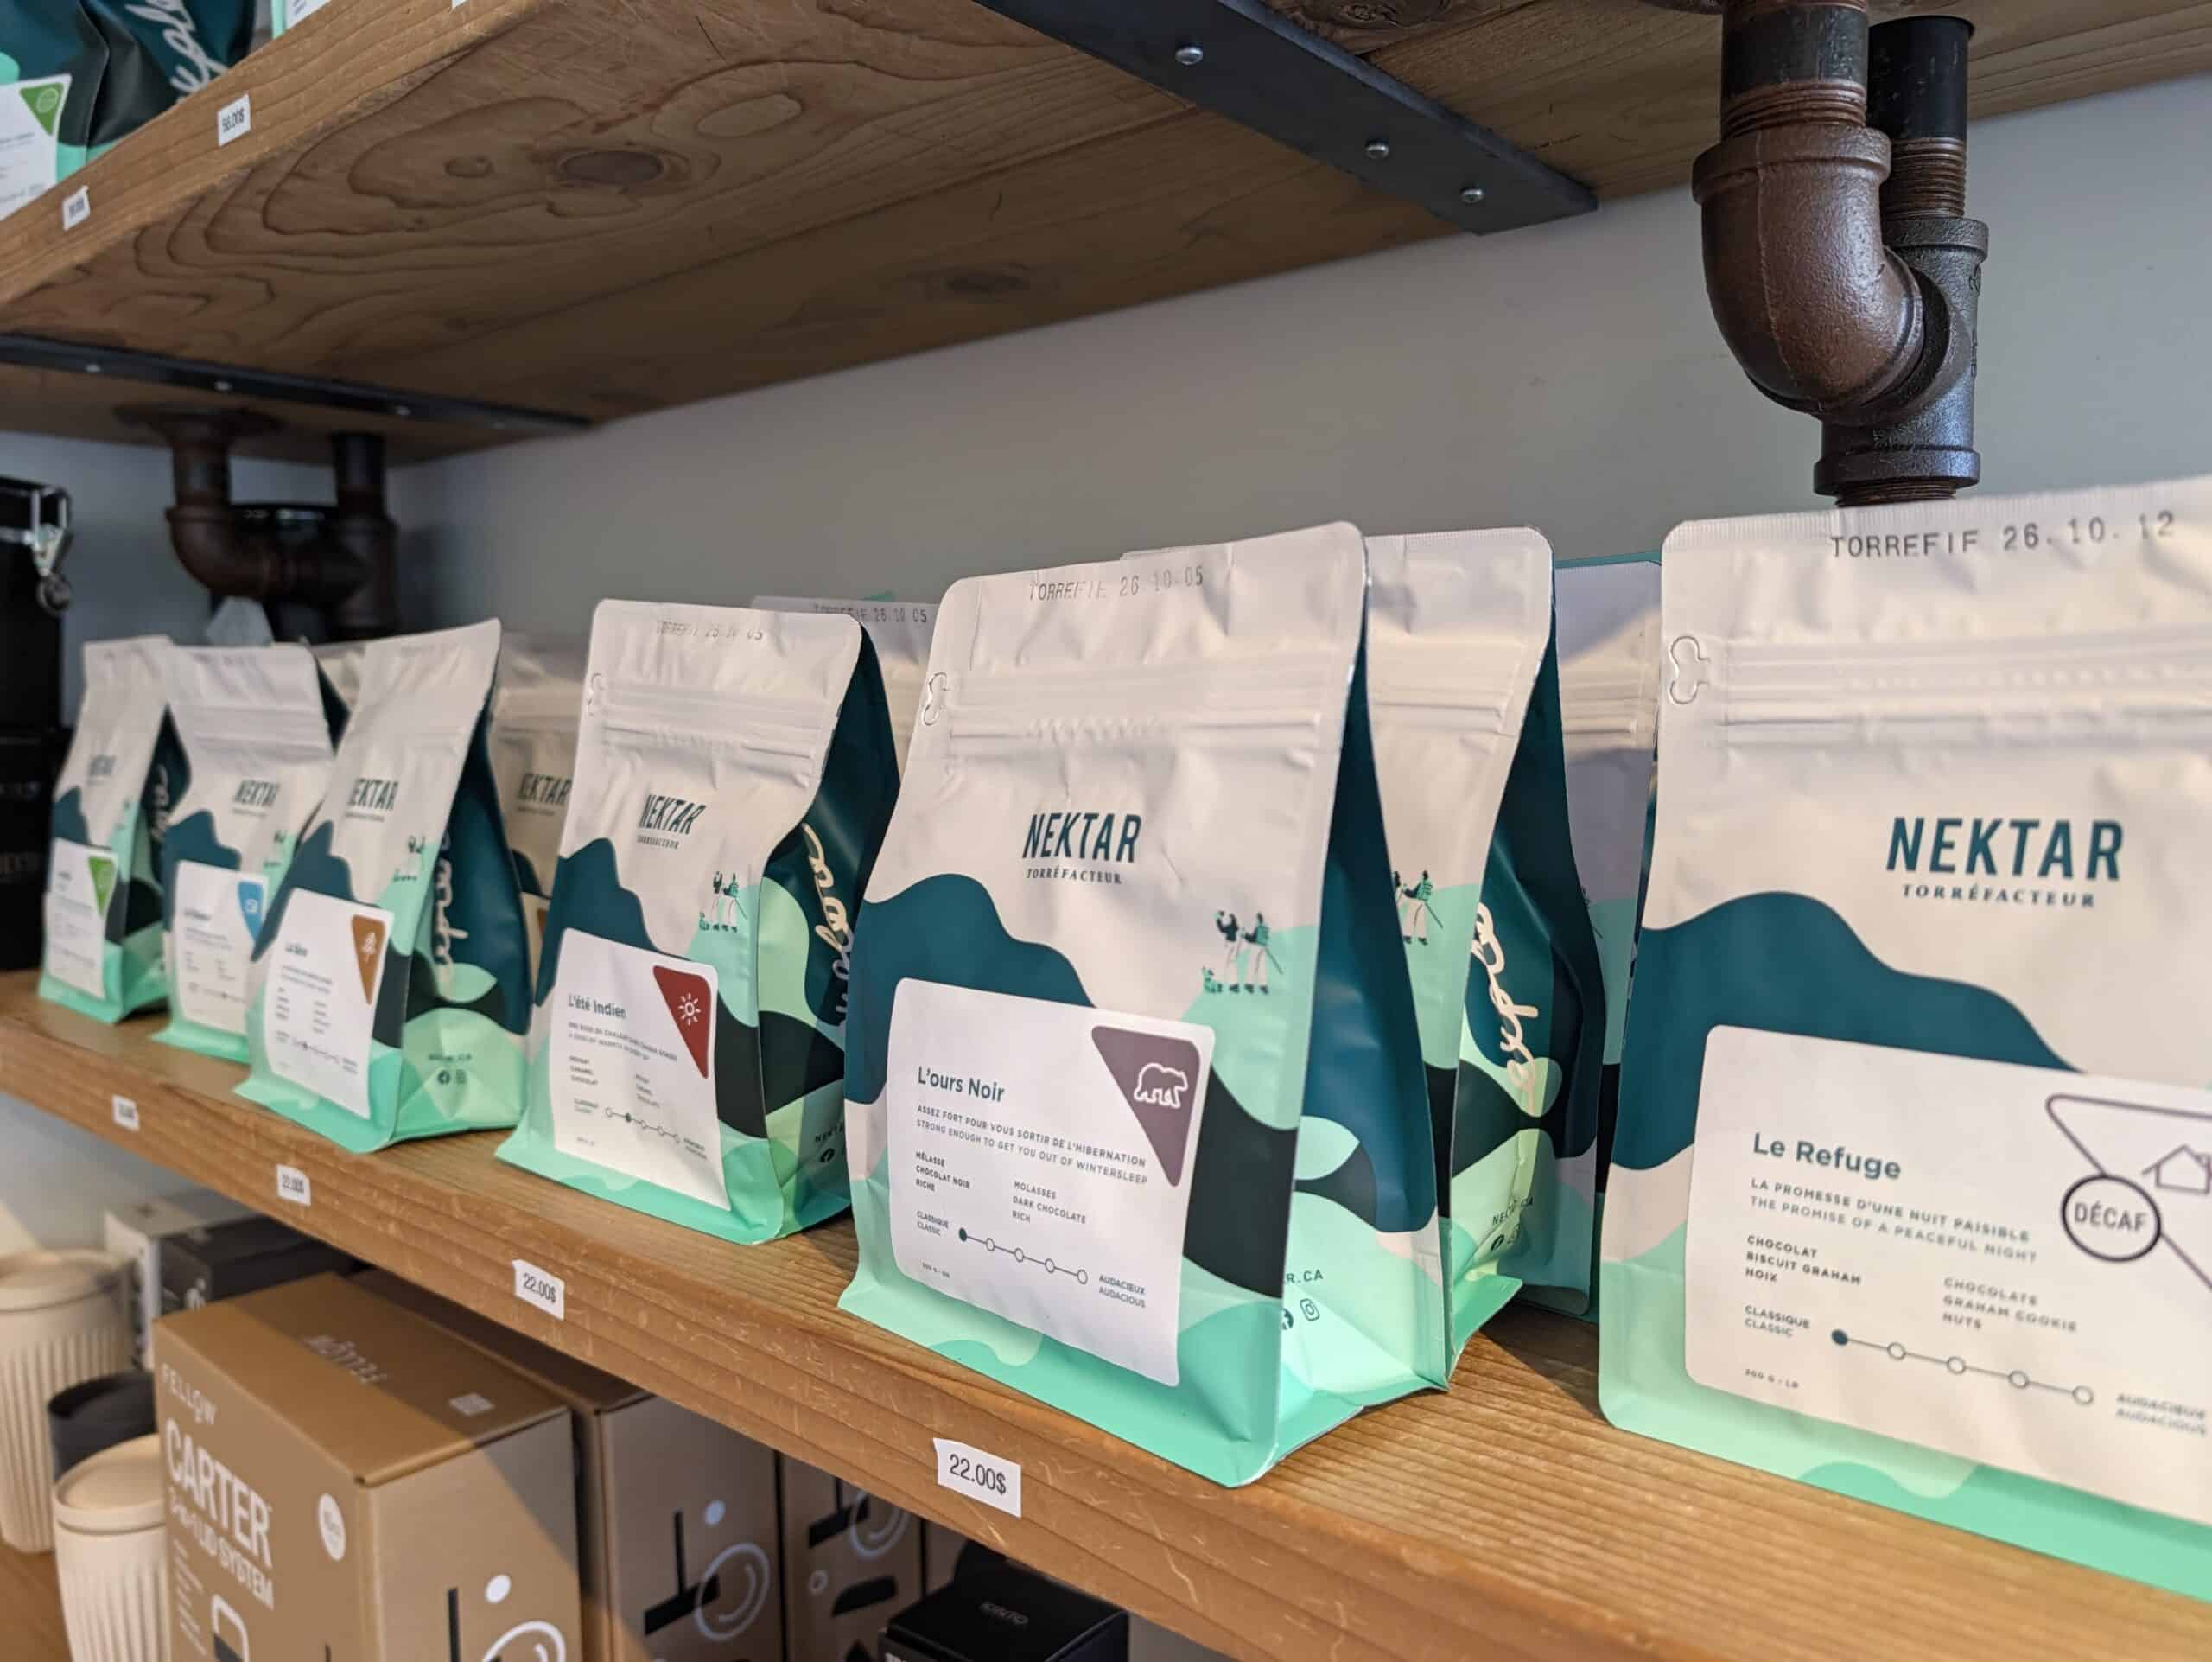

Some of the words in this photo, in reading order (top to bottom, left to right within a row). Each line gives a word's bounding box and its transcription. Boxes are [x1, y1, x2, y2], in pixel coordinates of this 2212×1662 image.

[638, 794, 707, 835] NEKTAR
[1022, 812, 1141, 863] NEKTAR
[1886, 817, 2125, 882] NEKTAR
[1027, 864, 1122, 884] TORRÉFACTEUR
[1903, 882, 2096, 909] TORRÉFACTEUR
[918, 1067, 964, 1093] L'ours
[969, 1077, 1005, 1102] Noir
[917, 1119, 946, 1135] STRONG
[949, 1127, 982, 1143] ENOUGH
[983, 1136, 995, 1148] TO
[997, 1140, 1014, 1153] GET
[1018, 1146, 1036, 1159] YOU
[1039, 1150, 1058, 1163] OUT
[1060, 1156, 1073, 1167] OF
[1076, 1160, 1148, 1186] WINTERSLEEP
[918, 1105, 940, 1118] ASSEZ
[943, 1111, 963, 1124] FORT
[965, 1117, 988, 1130] POUR
[990, 1124, 1014, 1137] VOUS
[1017, 1130, 1050, 1144] SORTIR
[1052, 1137, 1065, 1149] DE
[1067, 1142, 1147, 1168] L'HIBERNATION
[1753, 1133, 1785, 1157] Le
[1796, 1140, 1901, 1180] Refuge
[915, 1165, 950, 1183] CHOCOLAT
[952, 1176, 970, 1189] NOIR
[1014, 1181, 1057, 1200] MOLASSES
[1012, 1209, 1031, 1223] RICH
[1013, 1195, 1034, 1209] DARK
[1036, 1202, 1086, 1224] CHOCOLATE
[1751, 1178, 1769, 1190] LA
[1774, 1182, 1851, 1207] PROMESSE
[1857, 1199, 1903, 1218] D'UNE
[1910, 1210, 1947, 1227] NUIT
[1954, 1217, 2030, 1243] PAISIBLE
[2073, 1200, 2147, 1232] DÉCAF
[1750, 1196, 1776, 1209] THE
[1782, 1202, 1846, 1224] PROMISE
[1852, 1216, 1872, 1229] OF
[1878, 1222, 1889, 1233] A
[1895, 1226, 1978, 1252] PEACEFUL
[1984, 1243, 2037, 1263] NIGHT
[1747, 1235, 1818, 1258] CHOCOLAT
[1745, 1267, 1777, 1283] NOIX
[1746, 1251, 1797, 1270] BISCUIT
[1802, 1264, 1861, 1285] GRAHAM
[523, 1271, 556, 1303] 22.00$
[1943, 1277, 2037, 1306] CHOCOLATE
[1745, 1304, 1810, 1328] CLASSIQUE
[1942, 1295, 2010, 1316] GRAHAM
[1942, 1313, 1982, 1329] NUTS
[1745, 1318, 1793, 1338] CLASSIC
[950, 1454, 1007, 1495] 22.00$
[165, 1417, 272, 1569] CARTER
